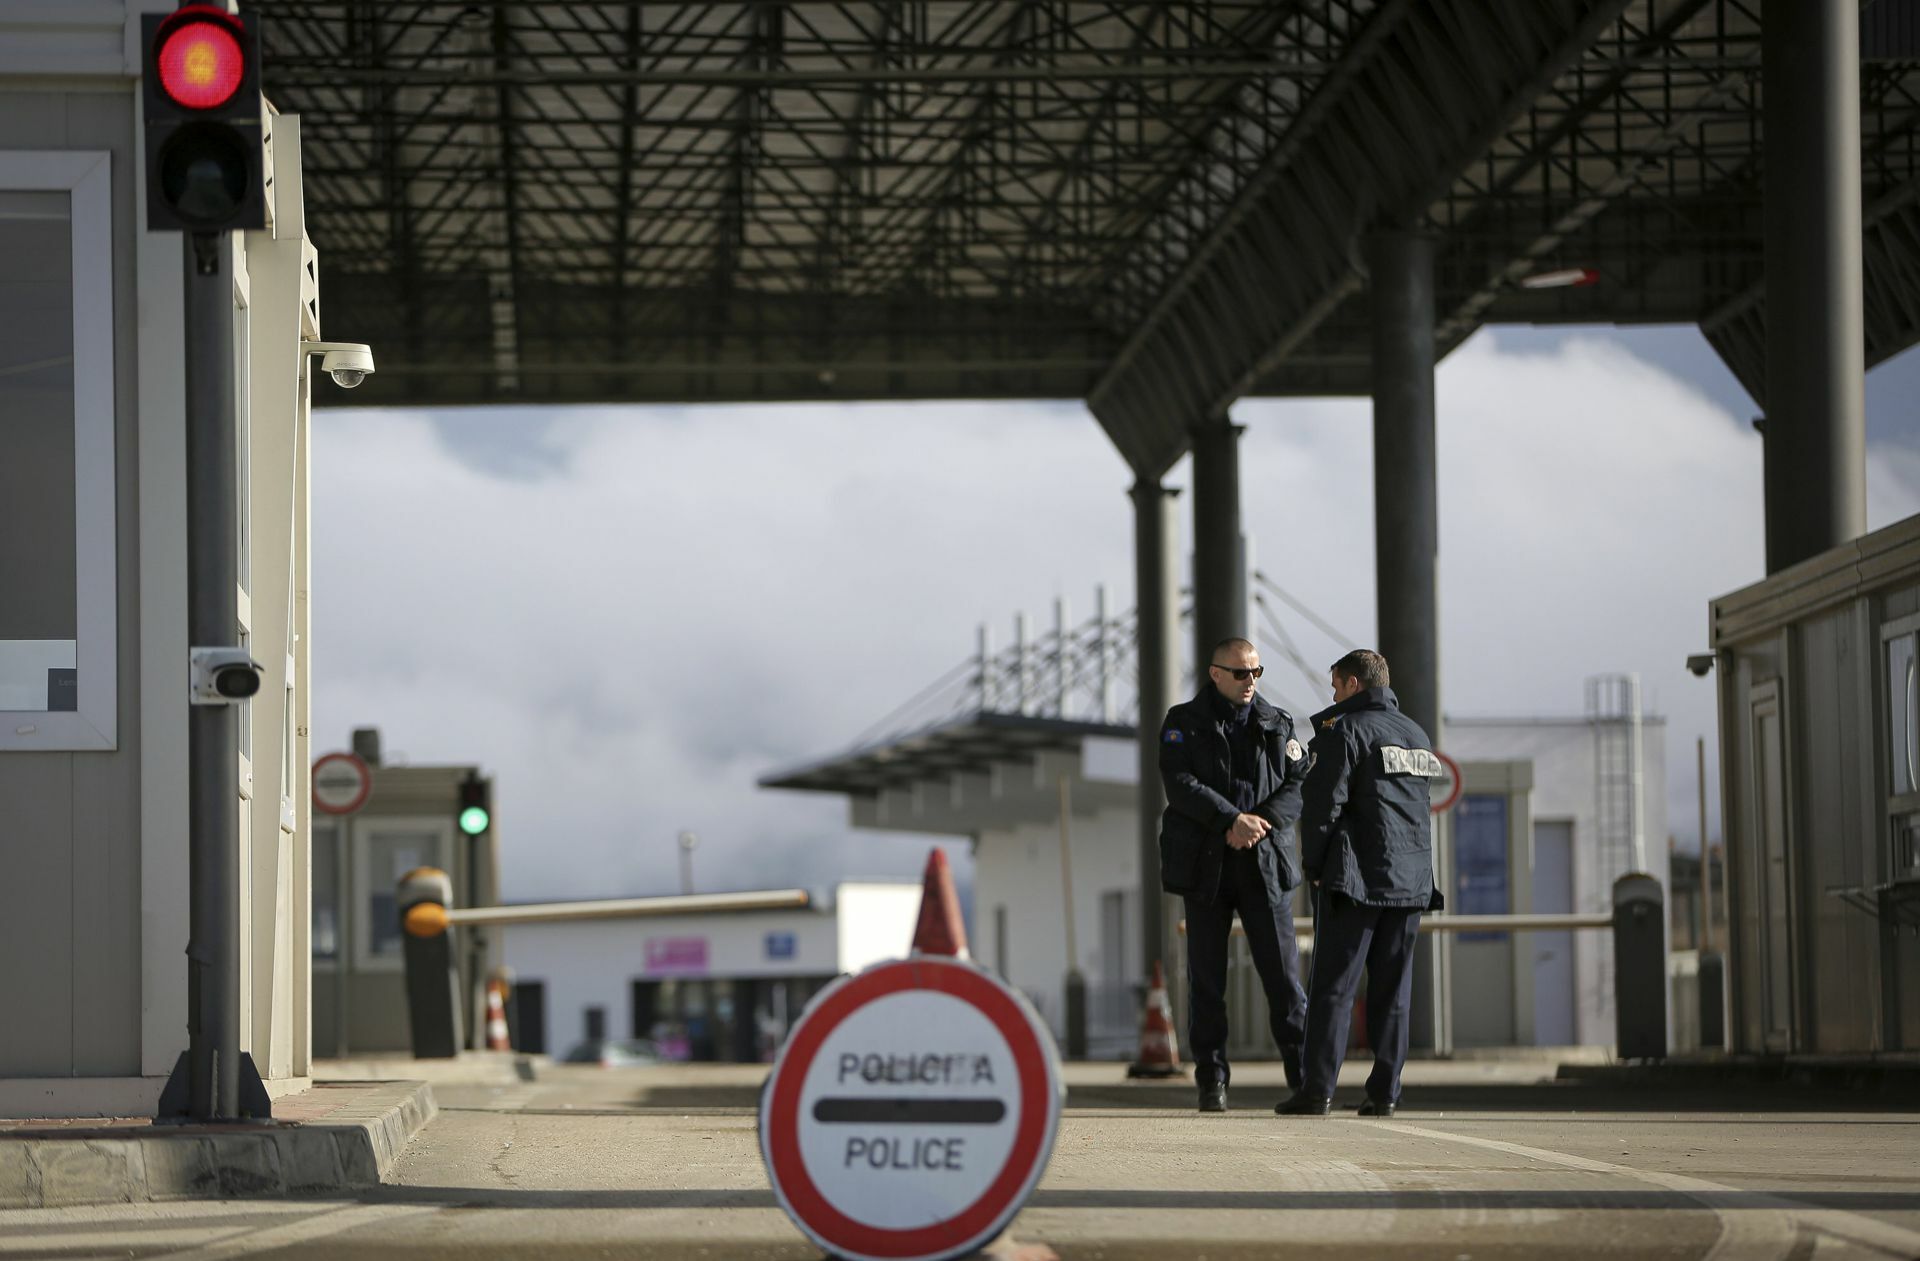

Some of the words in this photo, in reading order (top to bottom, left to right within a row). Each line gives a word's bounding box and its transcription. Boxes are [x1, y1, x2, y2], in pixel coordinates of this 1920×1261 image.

[1386, 749, 1439, 773] PICE
[837, 1053, 995, 1084] POLICIA
[844, 1137, 965, 1169] POLICE
